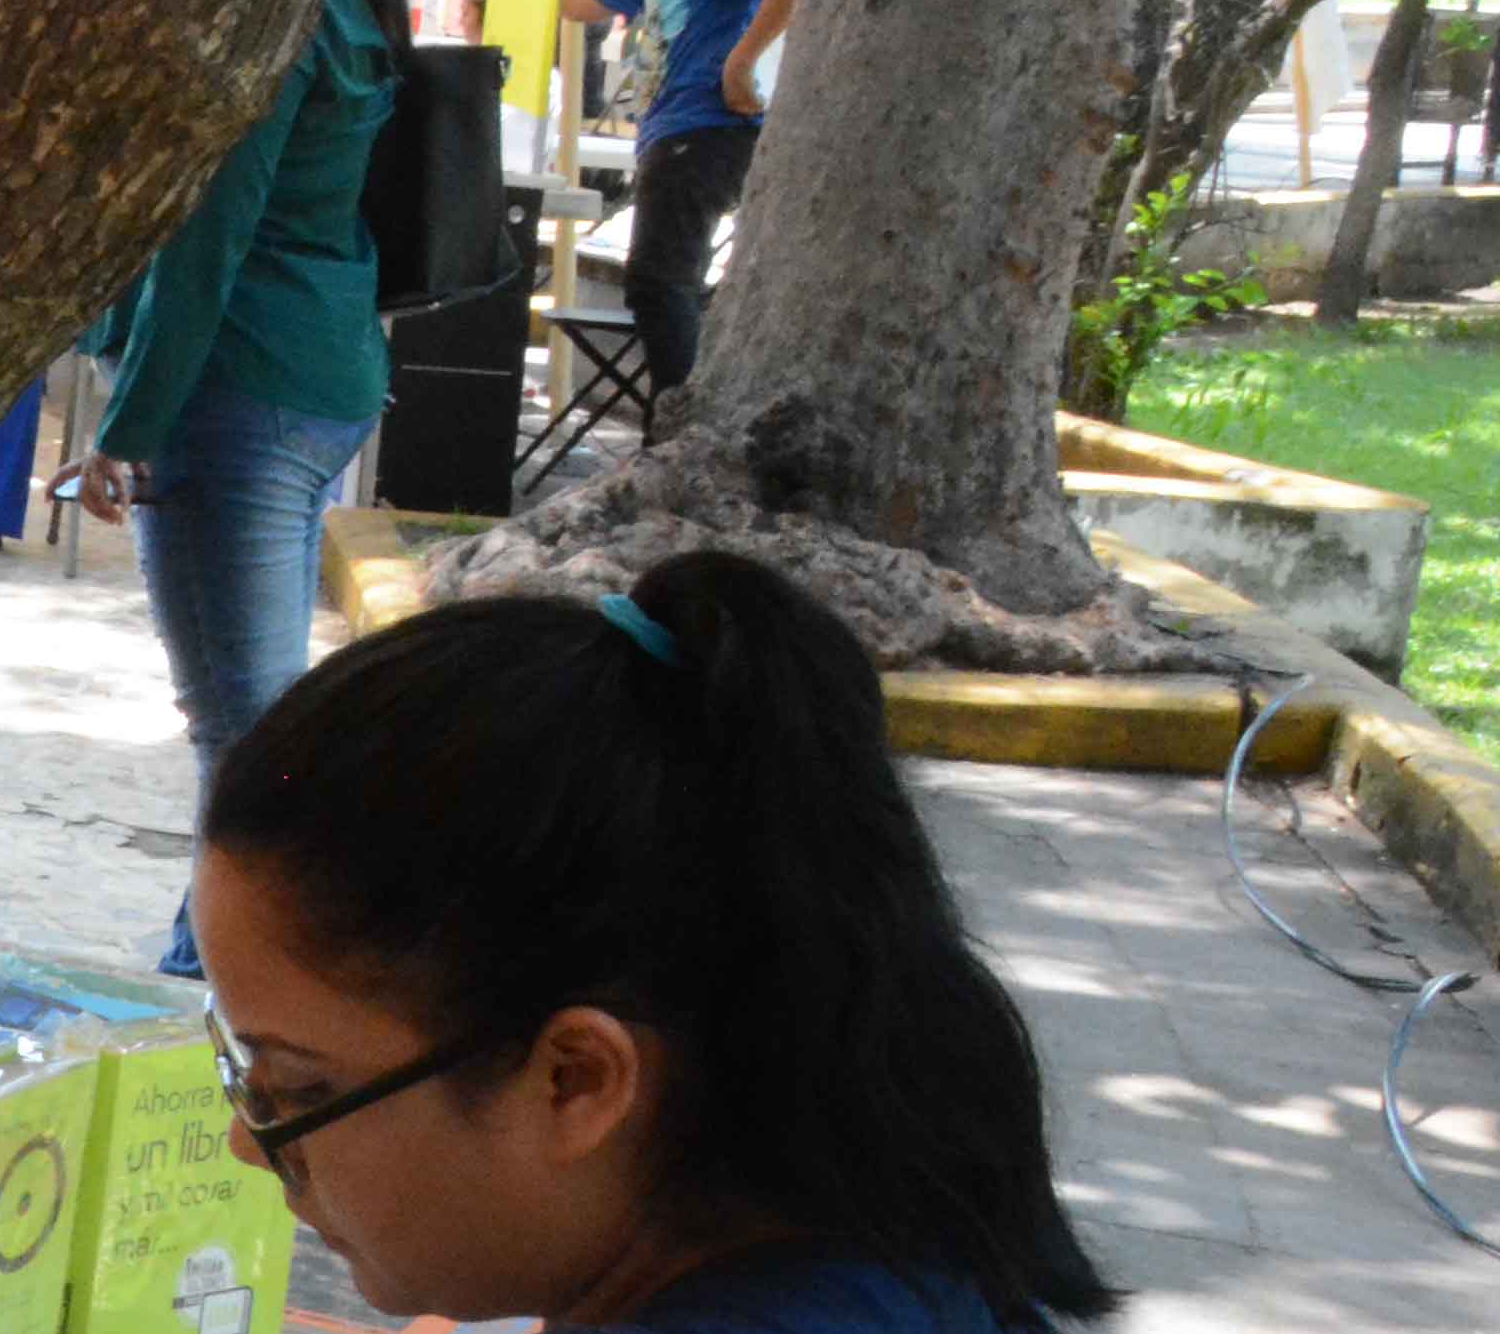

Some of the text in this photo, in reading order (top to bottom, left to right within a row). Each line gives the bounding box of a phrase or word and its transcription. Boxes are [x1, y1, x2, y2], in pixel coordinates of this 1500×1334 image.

[133, 1083, 214, 1118] Ahorra
[125, 1122, 227, 1172] un libr
